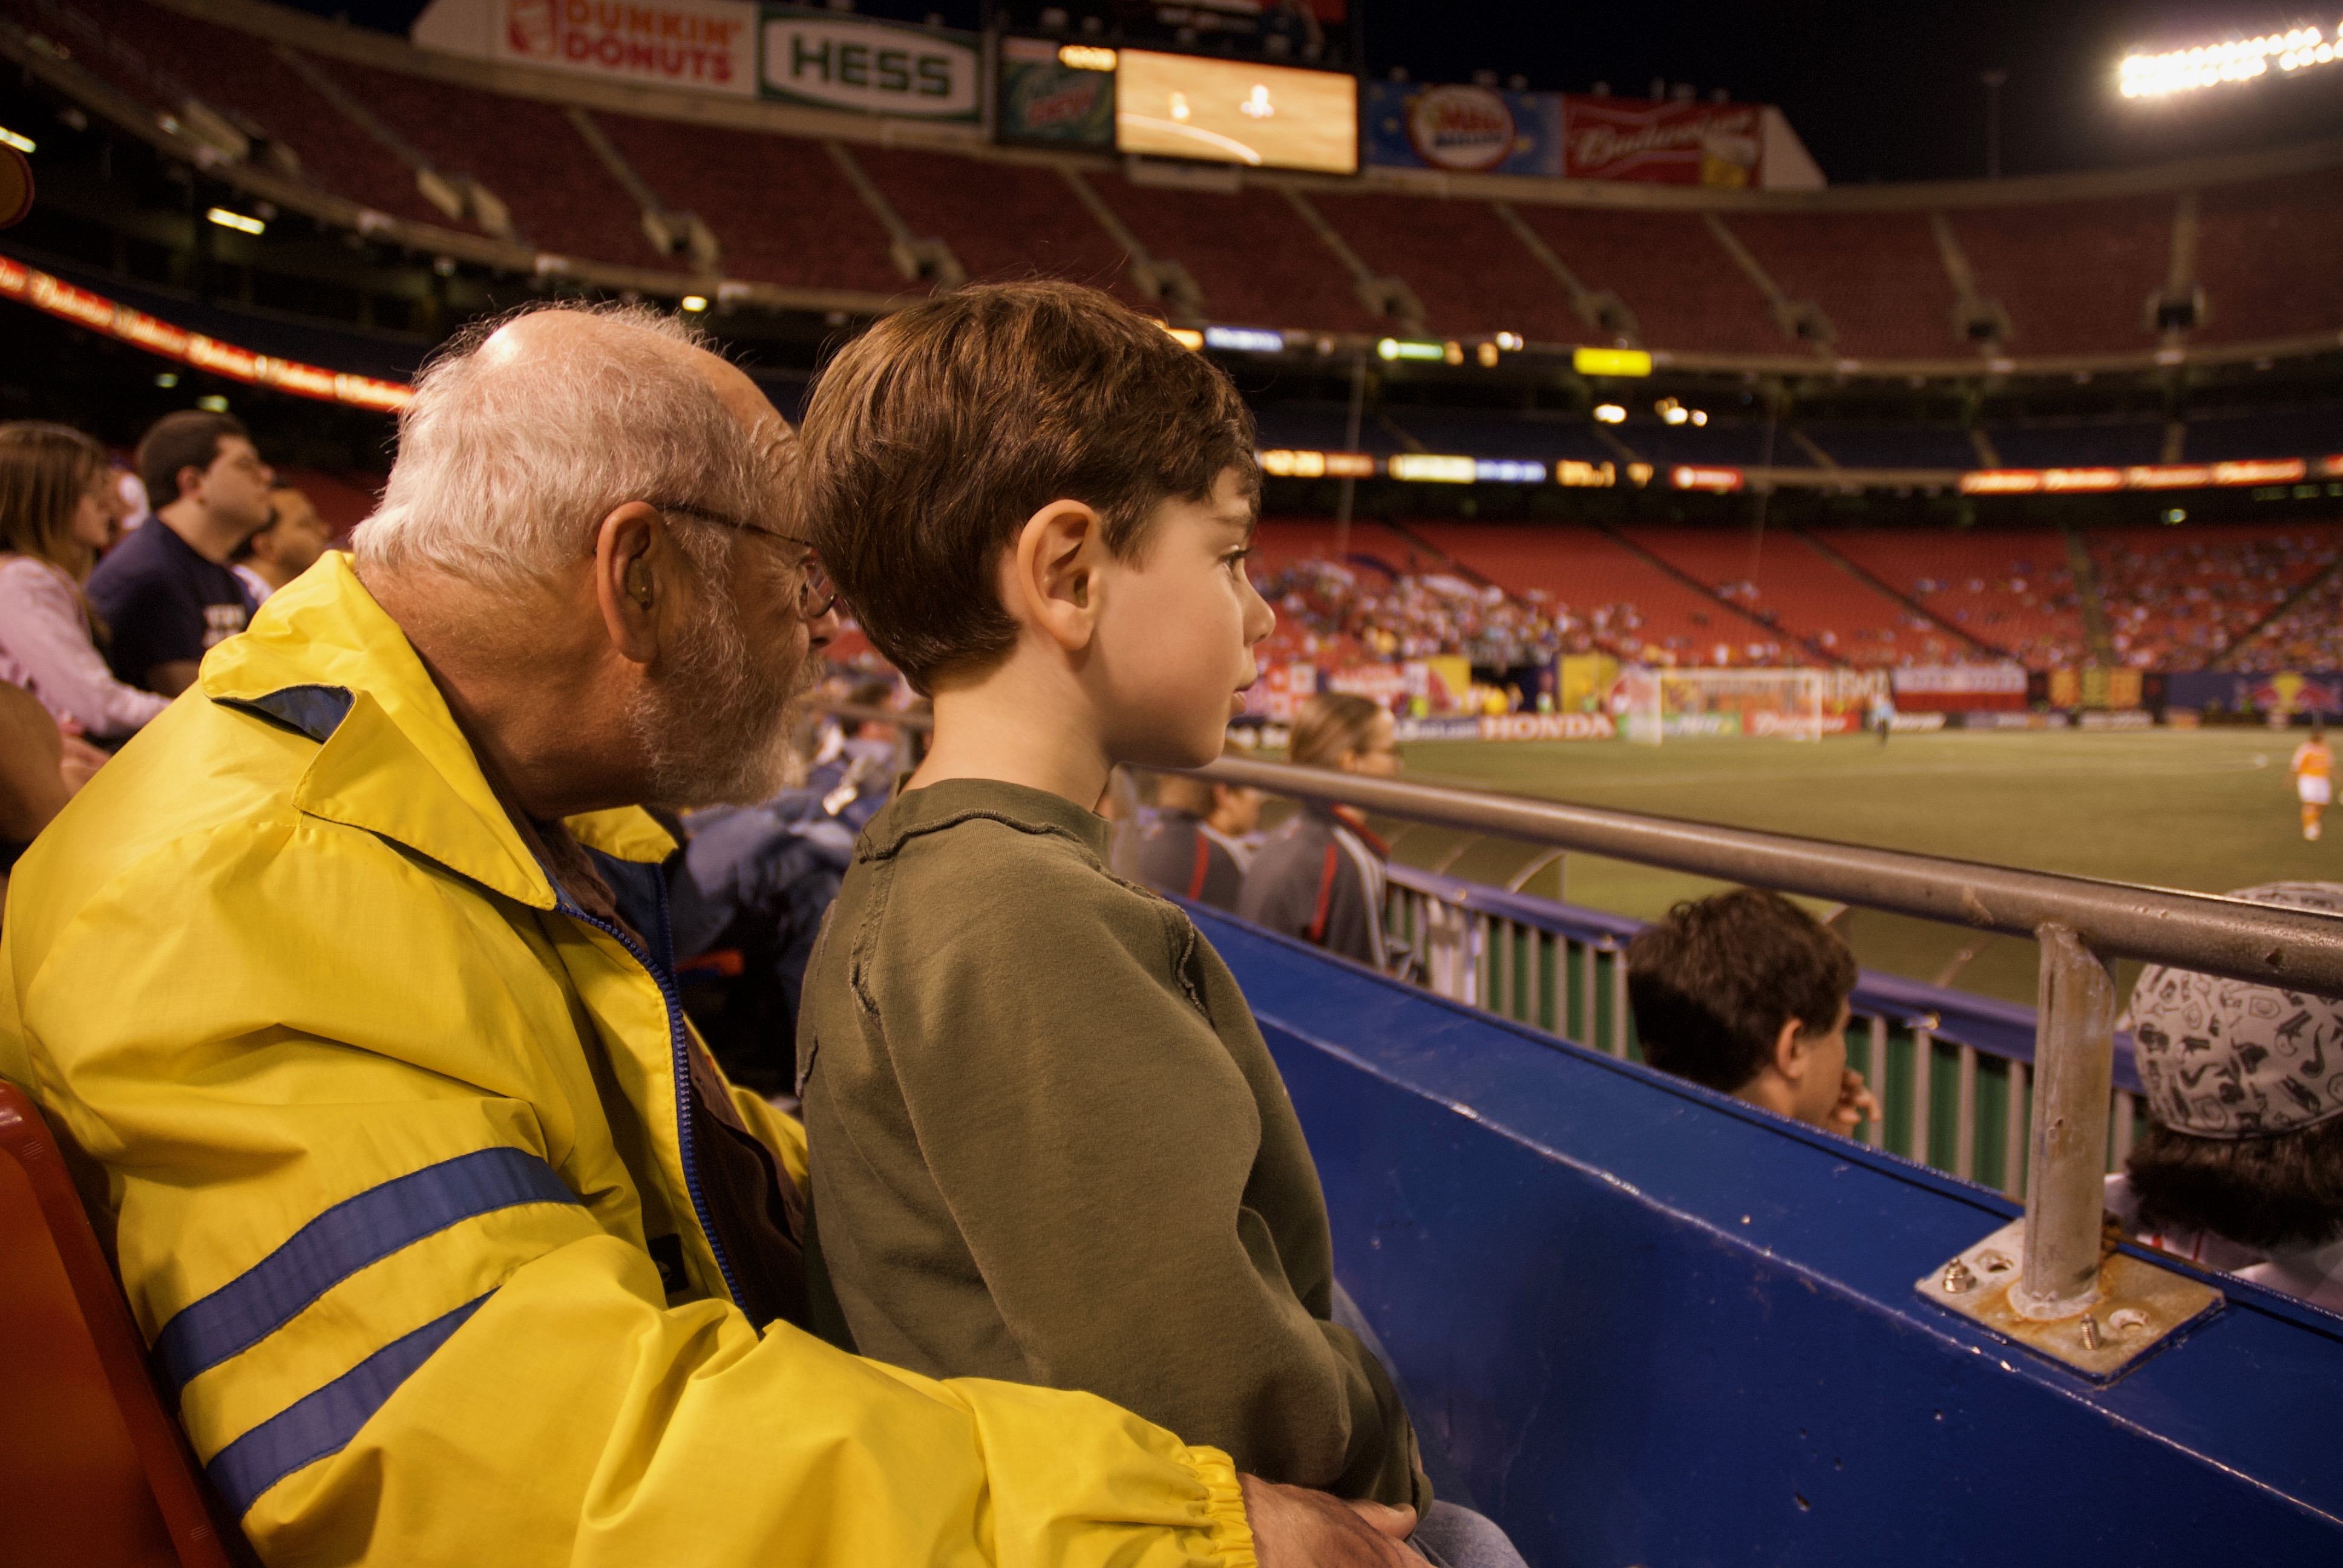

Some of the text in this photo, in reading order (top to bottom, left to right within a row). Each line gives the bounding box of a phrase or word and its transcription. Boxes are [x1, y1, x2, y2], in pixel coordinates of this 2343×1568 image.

[566, 31, 733, 81] DONUTS
[791, 32, 952, 97] HESS
[1481, 713, 1616, 740] HONDA
